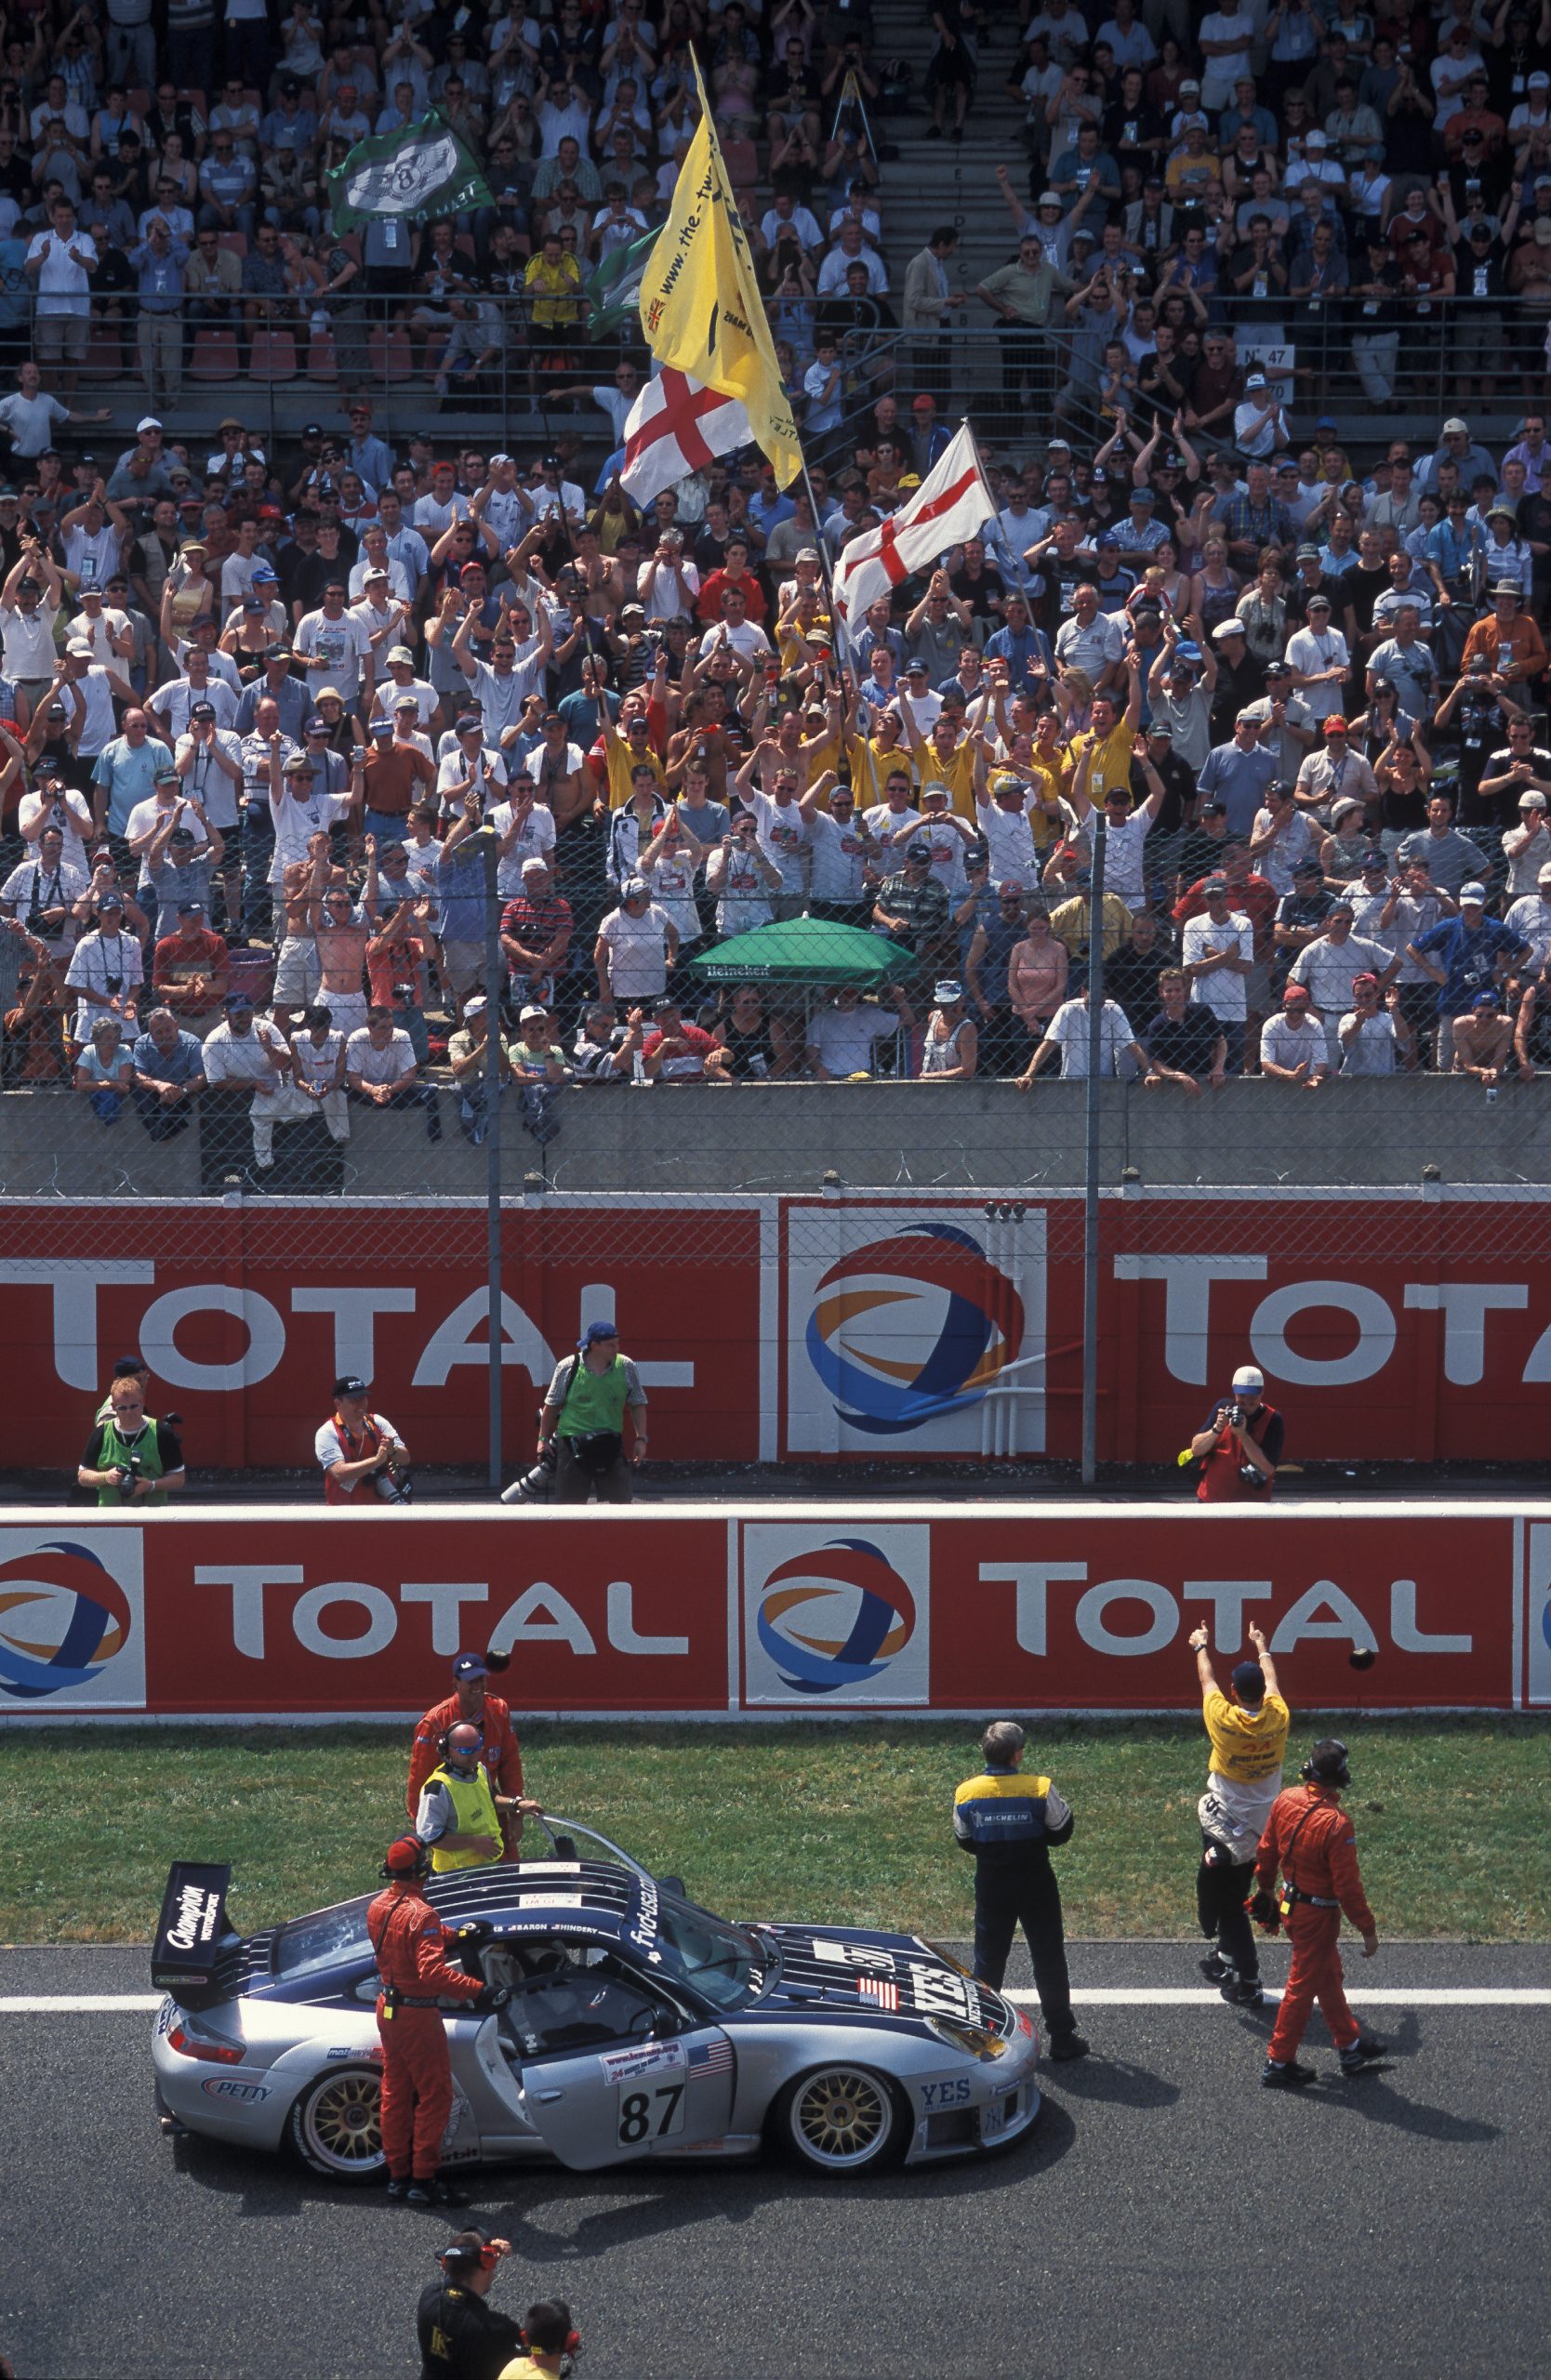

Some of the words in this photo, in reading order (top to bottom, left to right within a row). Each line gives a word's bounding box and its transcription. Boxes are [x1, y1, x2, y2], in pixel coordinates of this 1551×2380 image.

[1268, 350, 1286, 364] 47
[707, 964, 770, 976] Heineken
[1114, 1255, 1551, 1385] TOT
[194, 1565, 689, 1659] TOTAL
[979, 1562, 1472, 1657] TOTAL
[984, 1814, 1028, 1822] MICHELIN
[166, 1885, 205, 1949] Champion
[560, 1924, 598, 1935] HINDERY
[630, 1878, 658, 1949] fvd-usa.co
[908, 1962, 968, 2018] YES
[217, 2081, 273, 2101] PETTY
[618, 2082, 685, 2144] 87
[921, 2078, 971, 2106] YES
